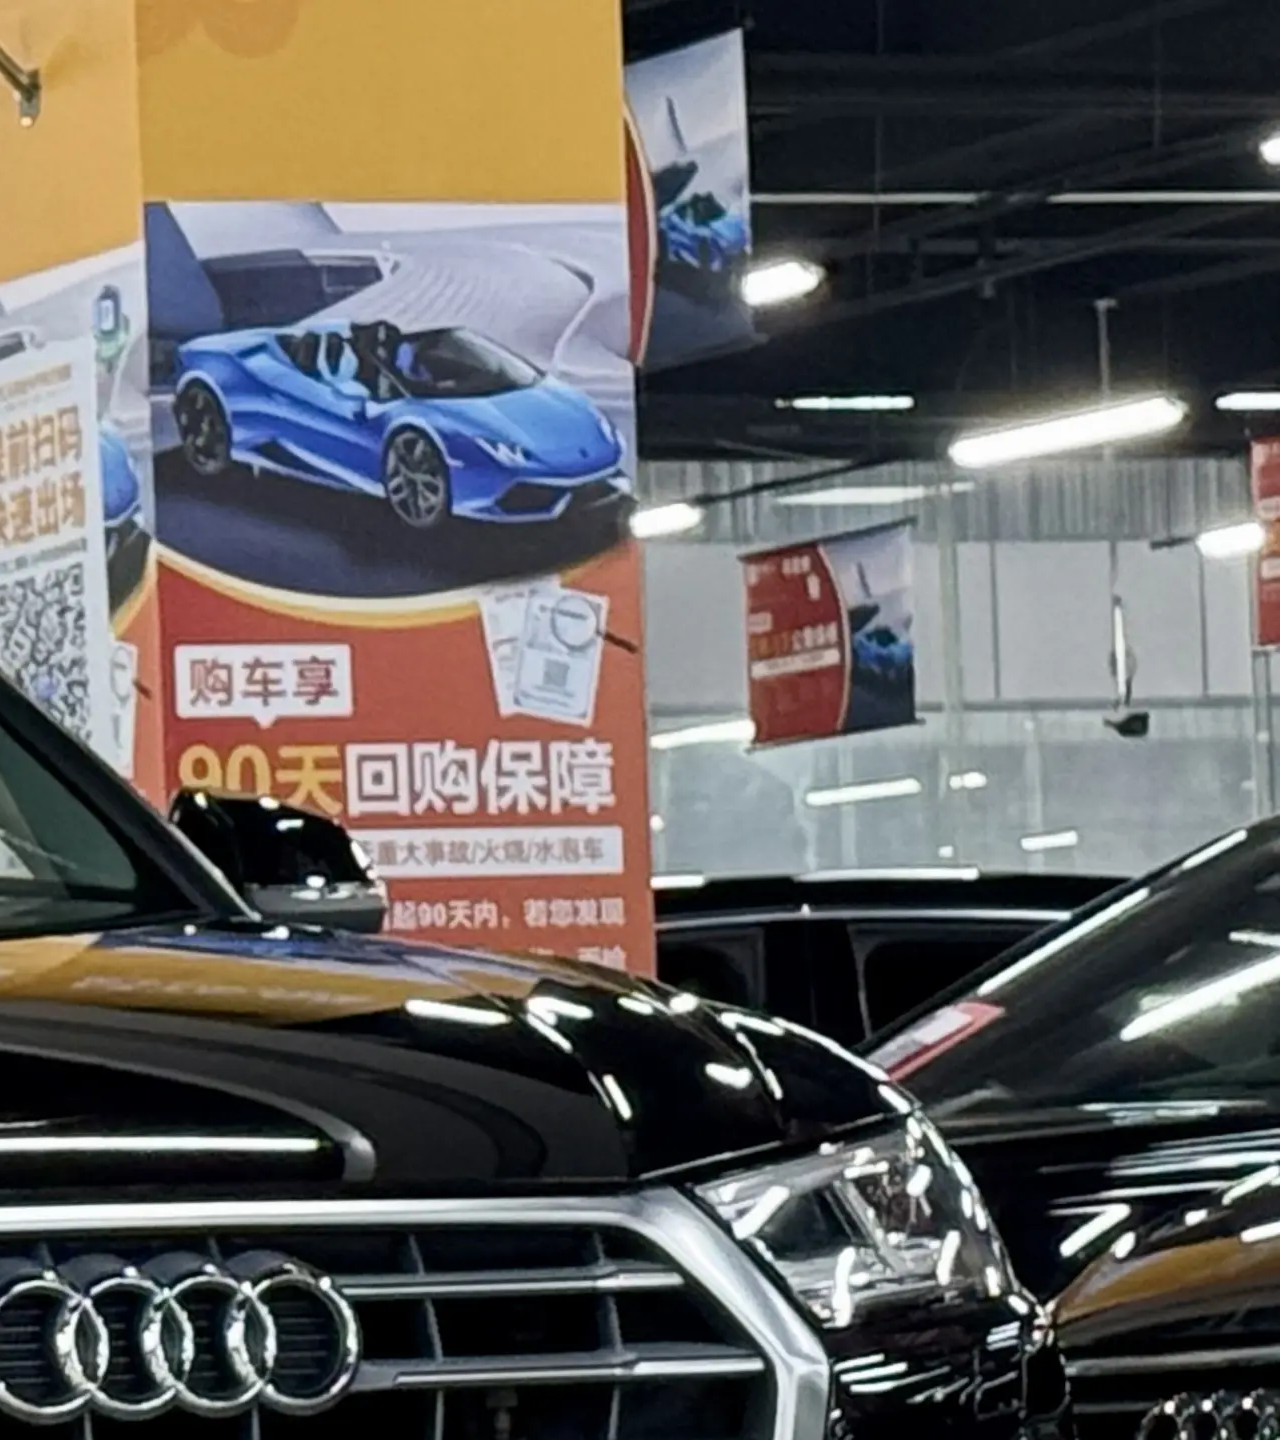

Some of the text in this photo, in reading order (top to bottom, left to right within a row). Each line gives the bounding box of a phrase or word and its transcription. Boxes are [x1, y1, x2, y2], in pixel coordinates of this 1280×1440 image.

[188, 655, 340, 709] 购车享
[178, 737, 617, 818] 90天回购保障
